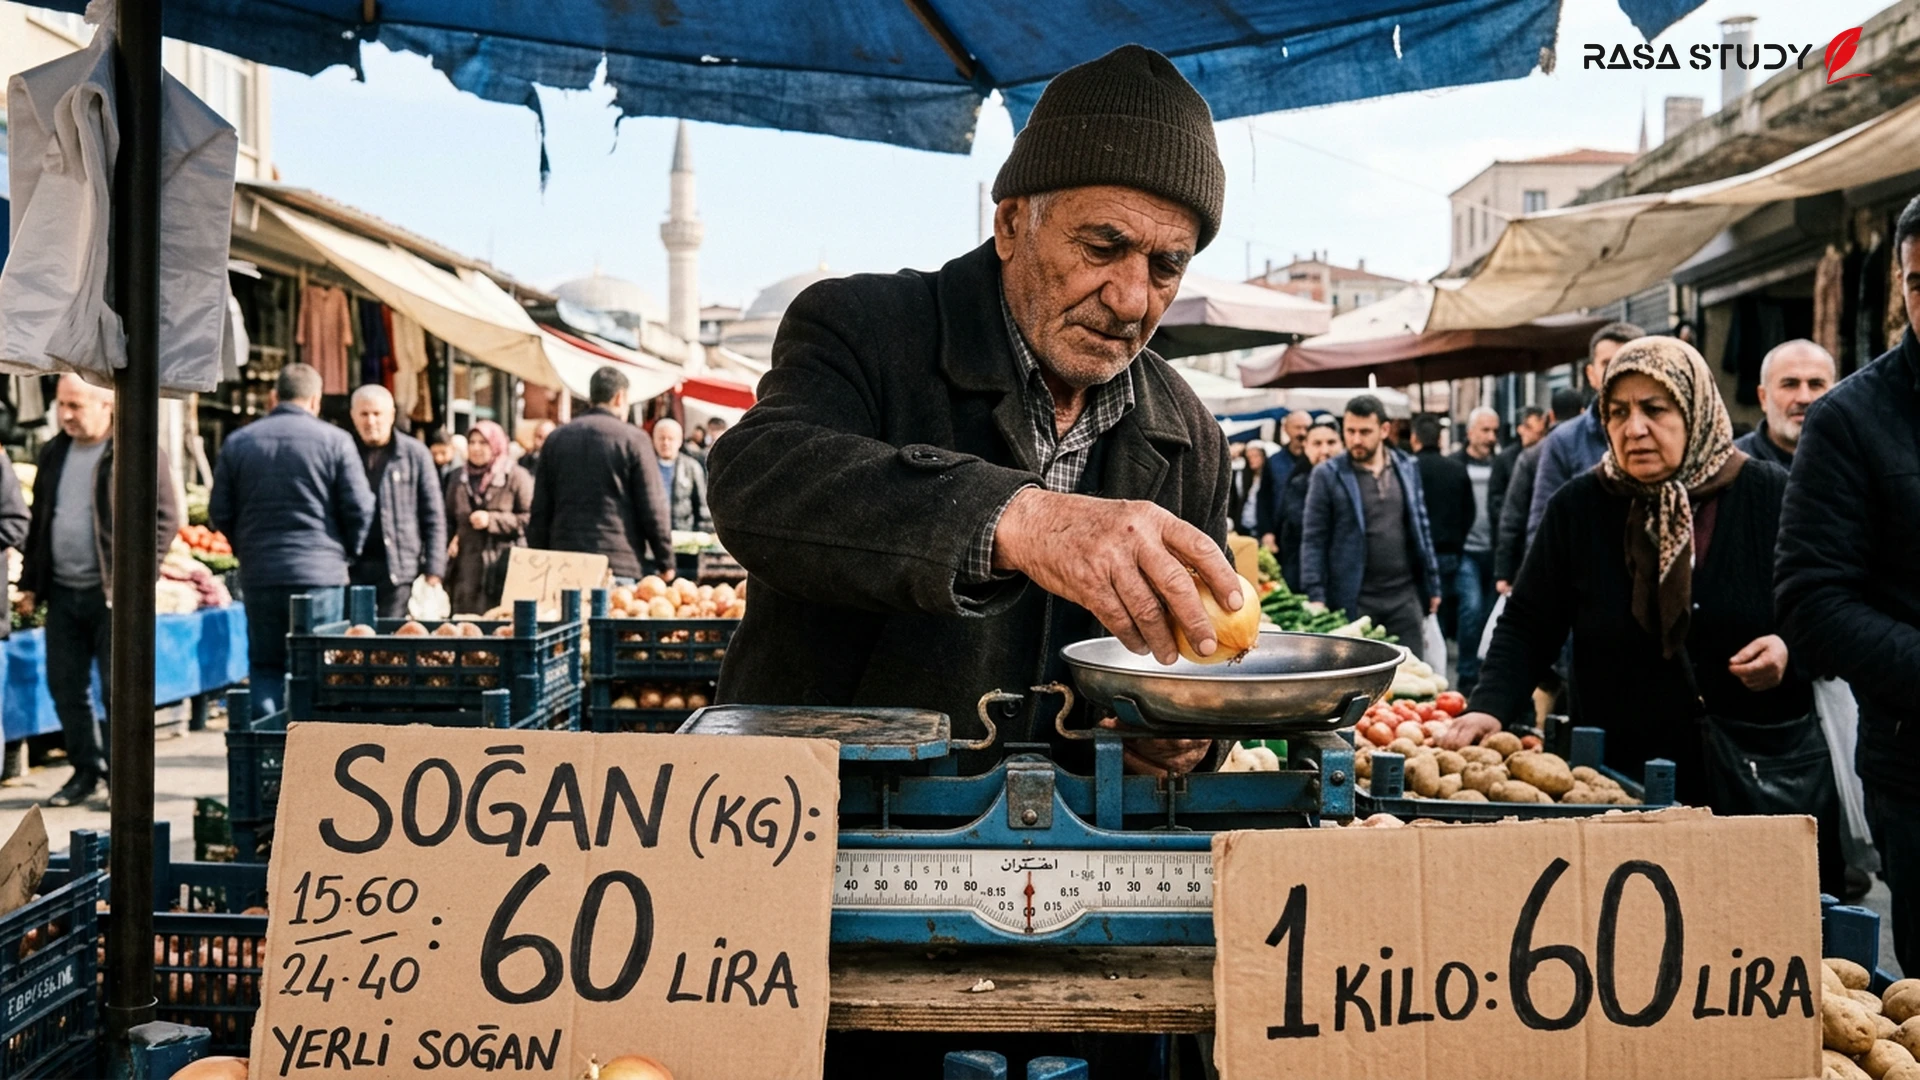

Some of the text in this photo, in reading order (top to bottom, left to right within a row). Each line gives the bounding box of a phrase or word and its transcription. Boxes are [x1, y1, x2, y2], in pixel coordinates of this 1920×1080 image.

[319, 744, 821, 867] SOĞAN (KG):
[844, 880, 859, 891] 40
[934, 880, 948, 891] 70
[1127, 881, 1141, 892] 30
[1156, 881, 1171, 892] 40
[1187, 881, 1201, 892] 50
[481, 863, 654, 1005] 60
[667, 938, 799, 1009] LİRA
[1265, 884, 1320, 1039] 1
[1509, 857, 1684, 1031] 60
[1692, 948, 1814, 1019] LİRA
[272, 1018, 563, 1077] YERLİ SOĞAN
